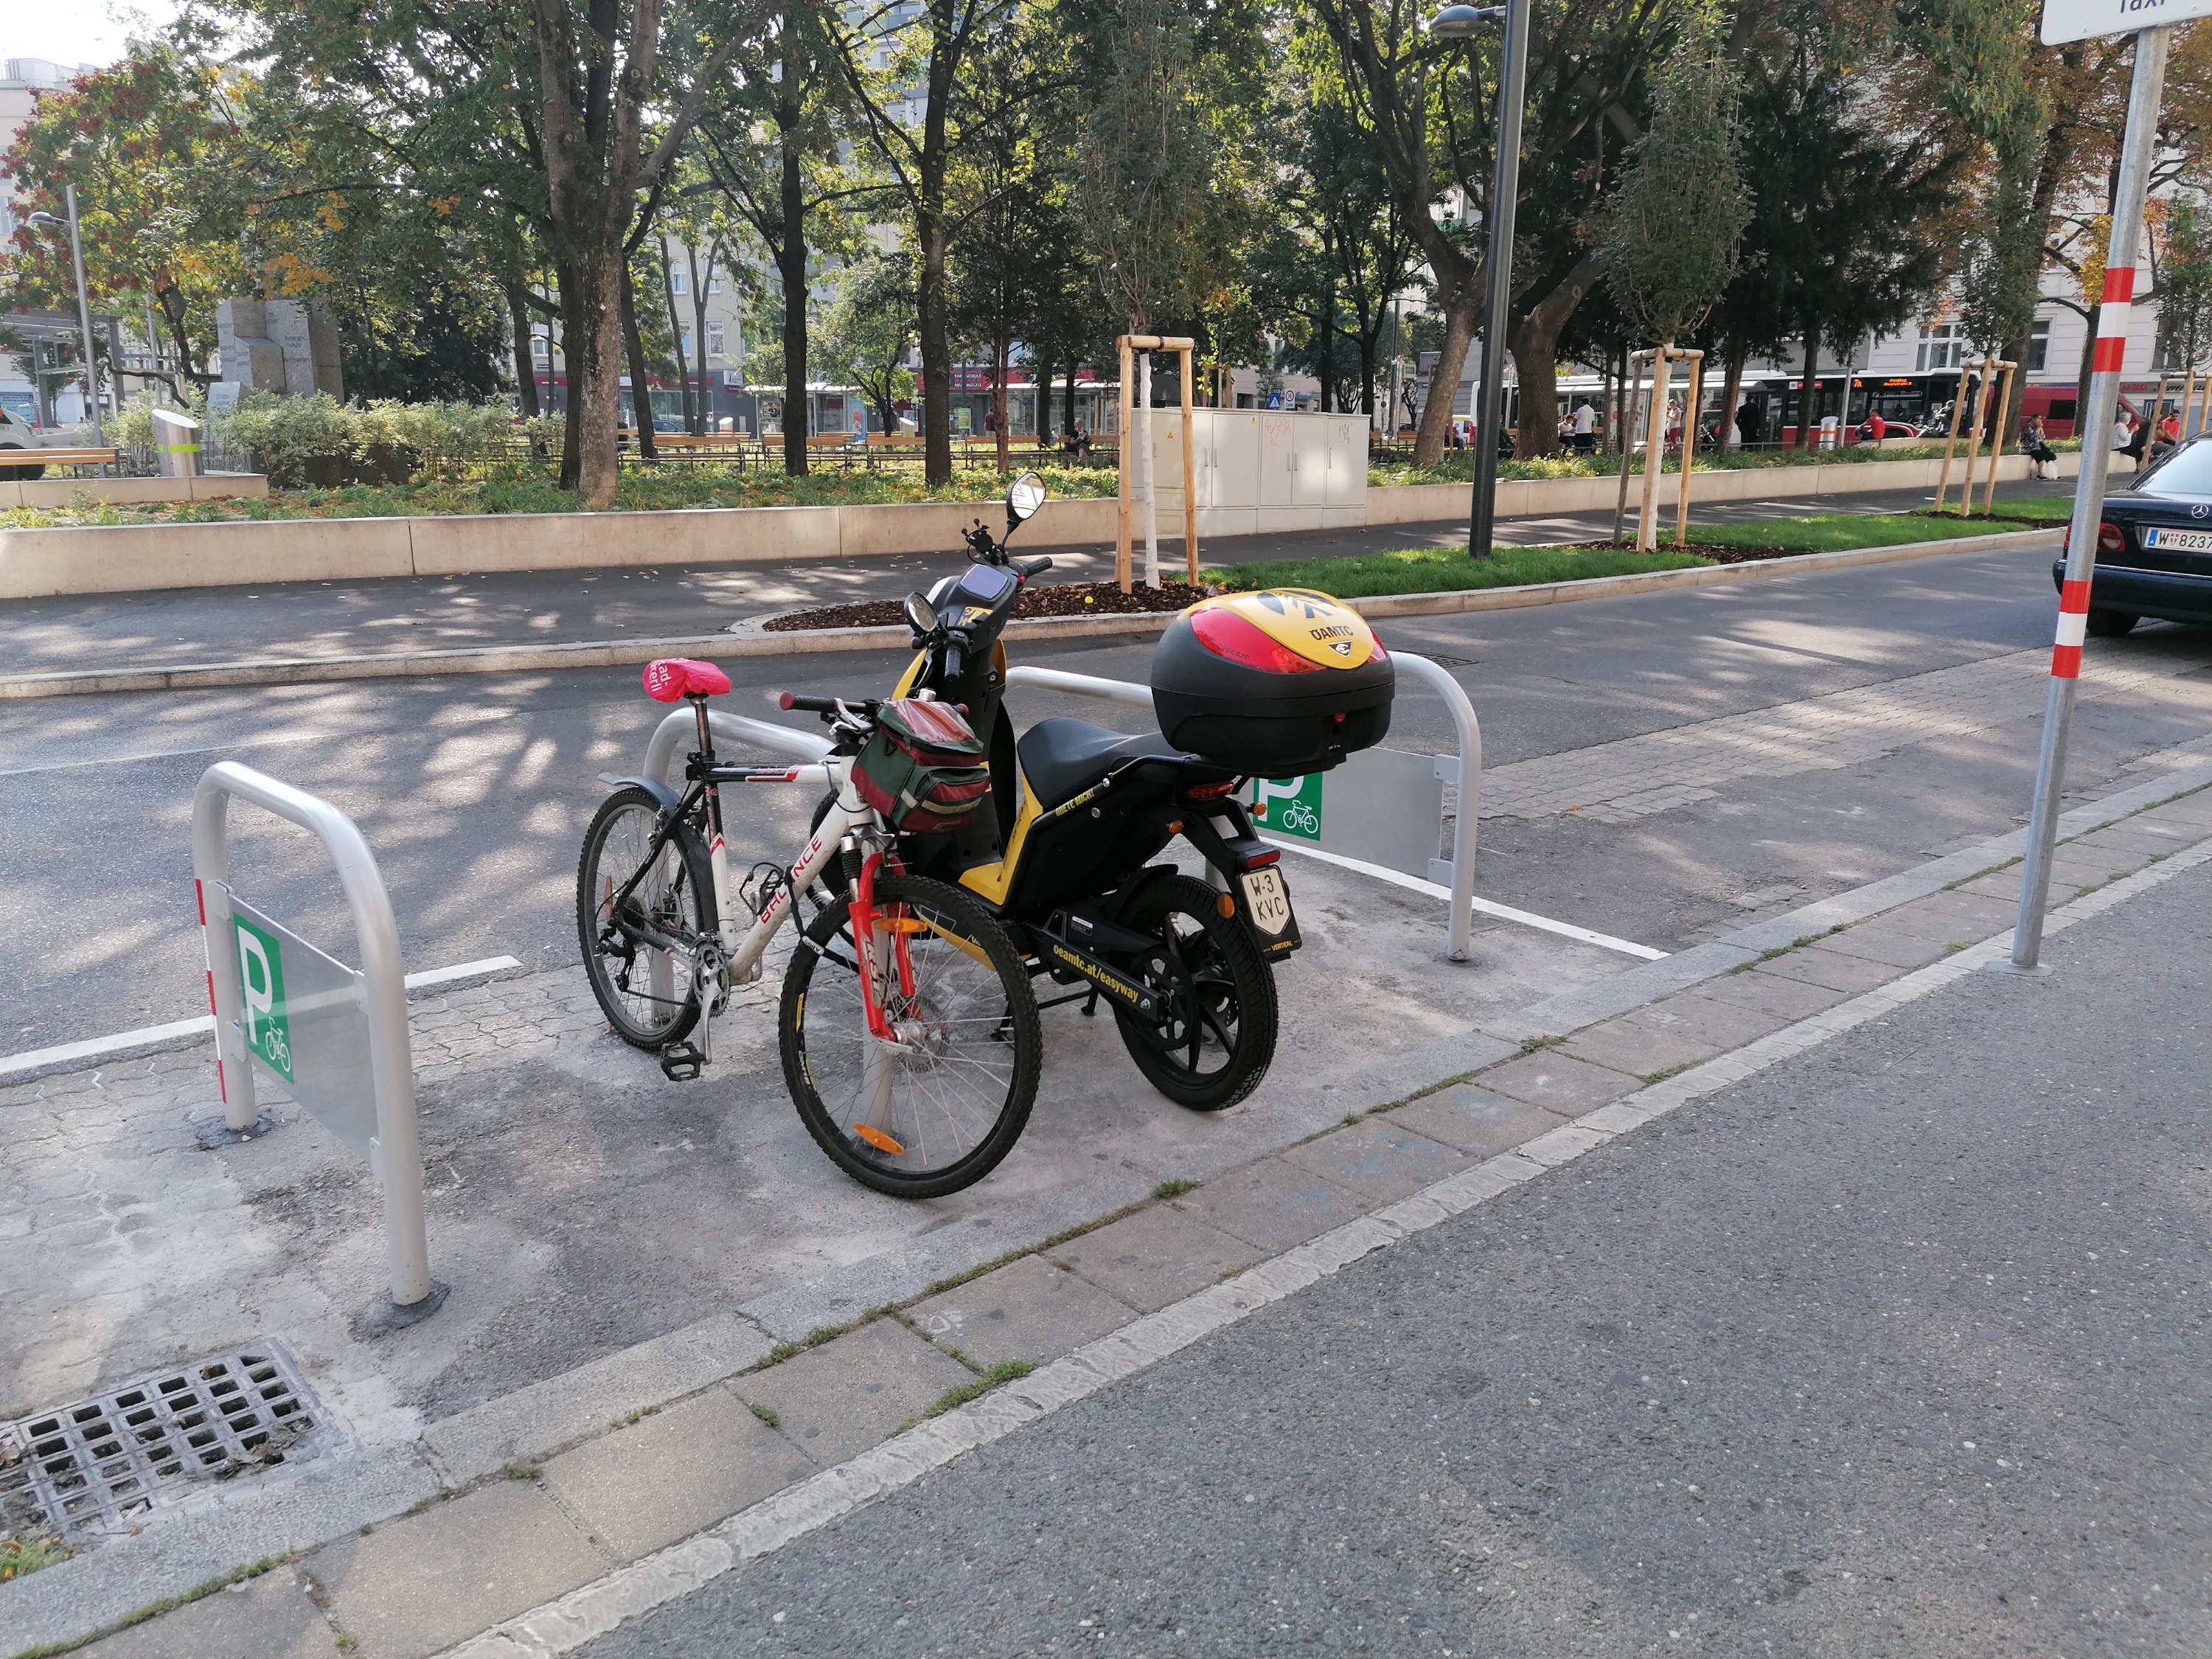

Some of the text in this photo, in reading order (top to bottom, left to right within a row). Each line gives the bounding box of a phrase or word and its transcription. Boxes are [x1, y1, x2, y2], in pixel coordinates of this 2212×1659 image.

[1256, 897, 1284, 921] KVC
[237, 925, 273, 1046] P
[1053, 944, 1139, 1003] oeamtc.at/easyway
